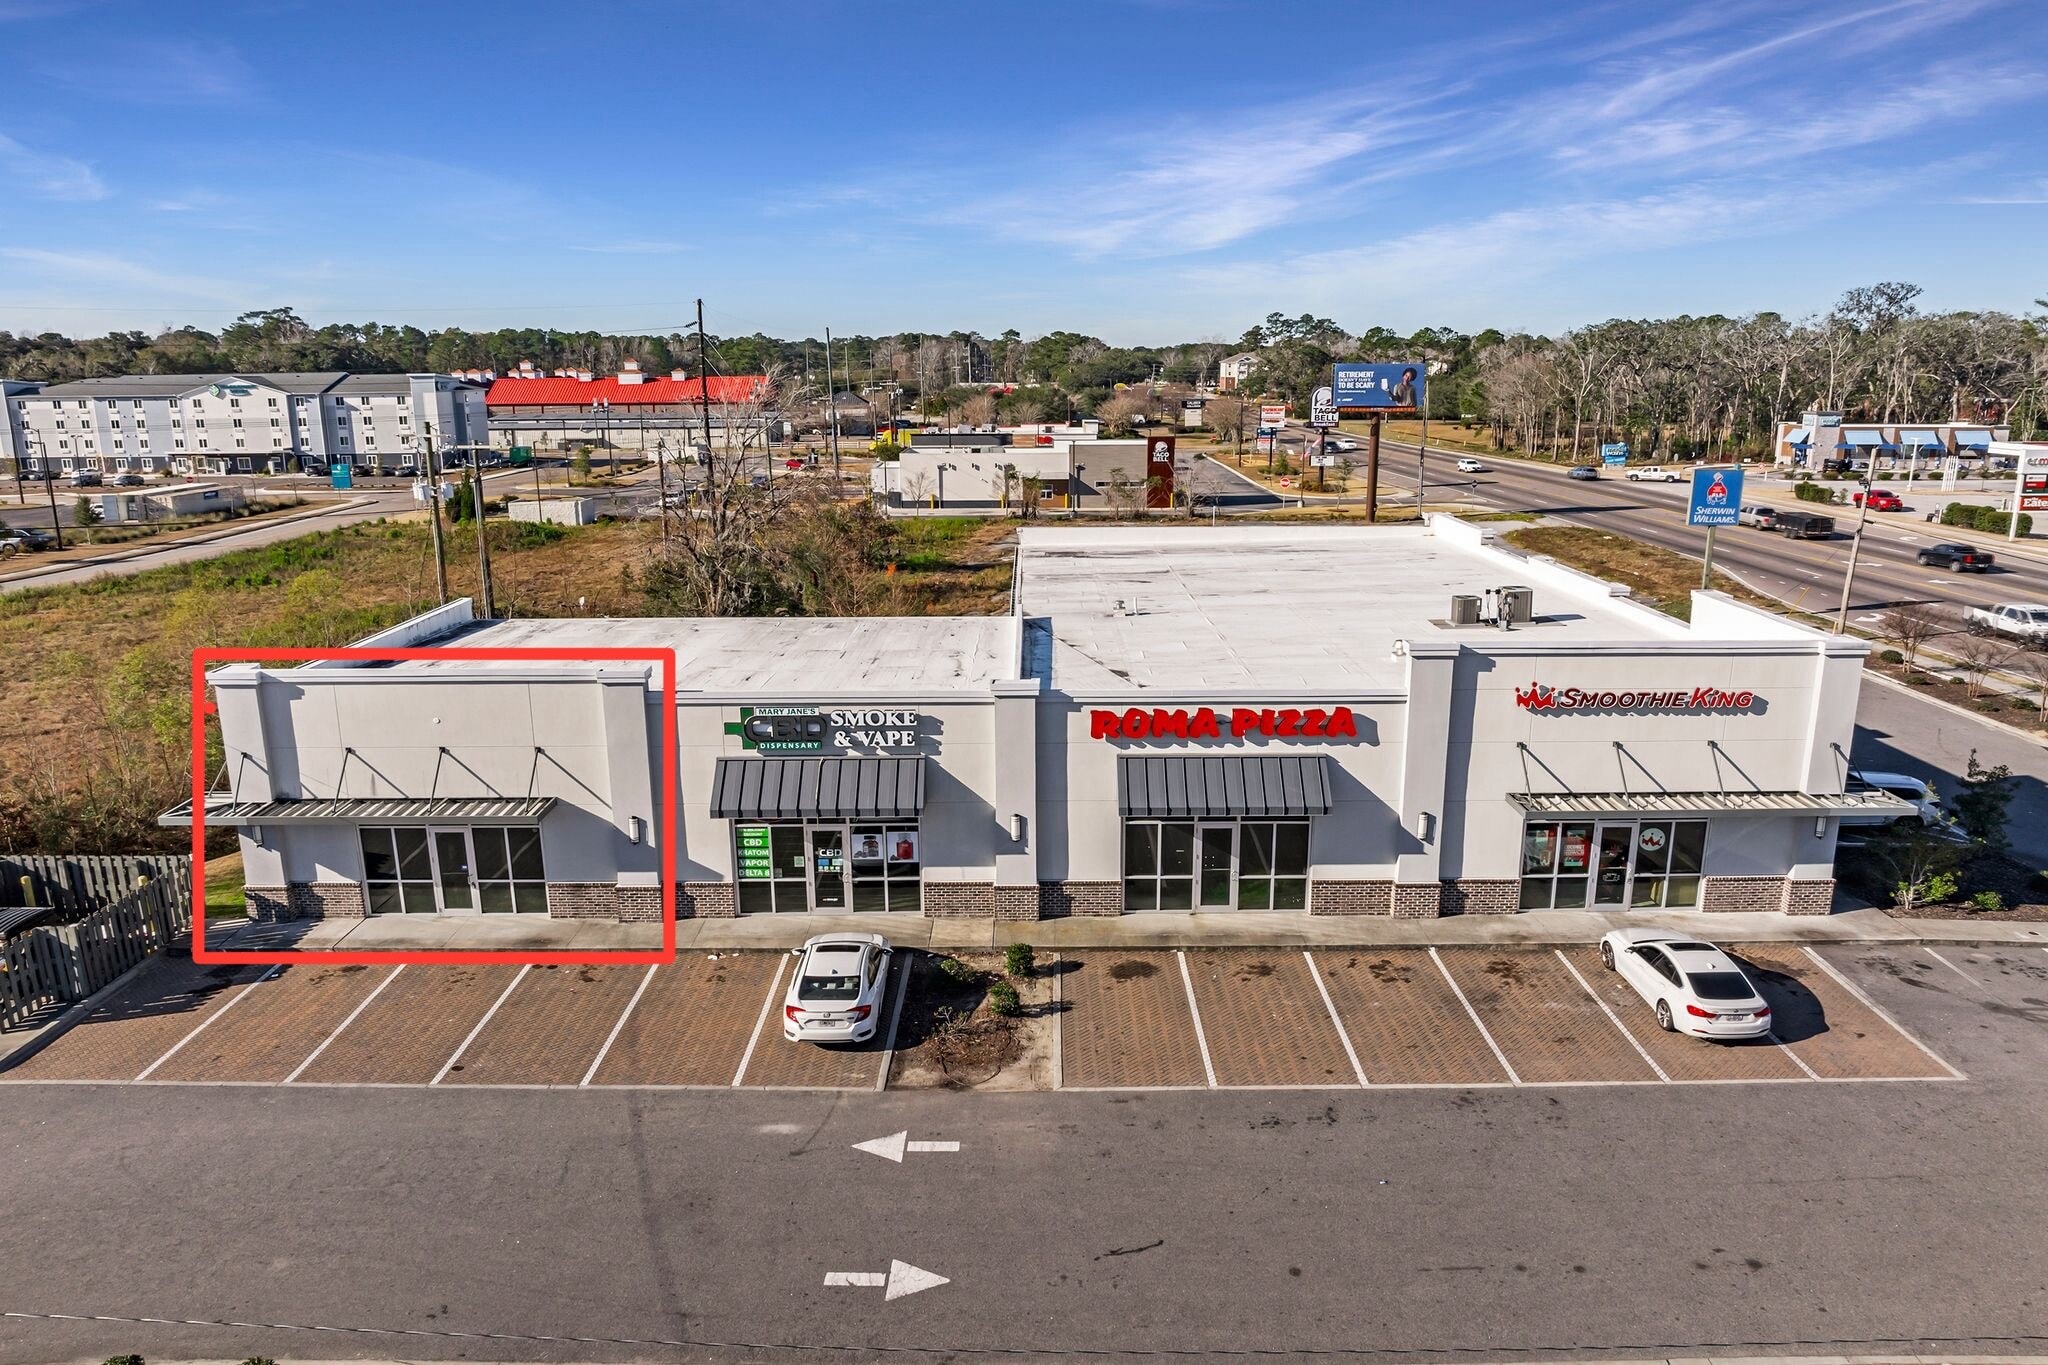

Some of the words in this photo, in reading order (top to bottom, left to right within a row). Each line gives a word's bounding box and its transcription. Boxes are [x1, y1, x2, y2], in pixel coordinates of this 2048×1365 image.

[2022, 498, 2048, 507] Eate
[1695, 506, 1736, 515] SHERWIN
[830, 709, 917, 727] SMOKE
[1090, 707, 1220, 739] ROMA
[1231, 706, 1357, 738] PIZZA
[744, 715, 827, 742] CBD
[833, 730, 852, 747] &
[857, 730, 916, 747] VAPE
[743, 838, 763, 846] CBD
[819, 848, 842, 857] CBD
[739, 869, 763, 877] DELTA
